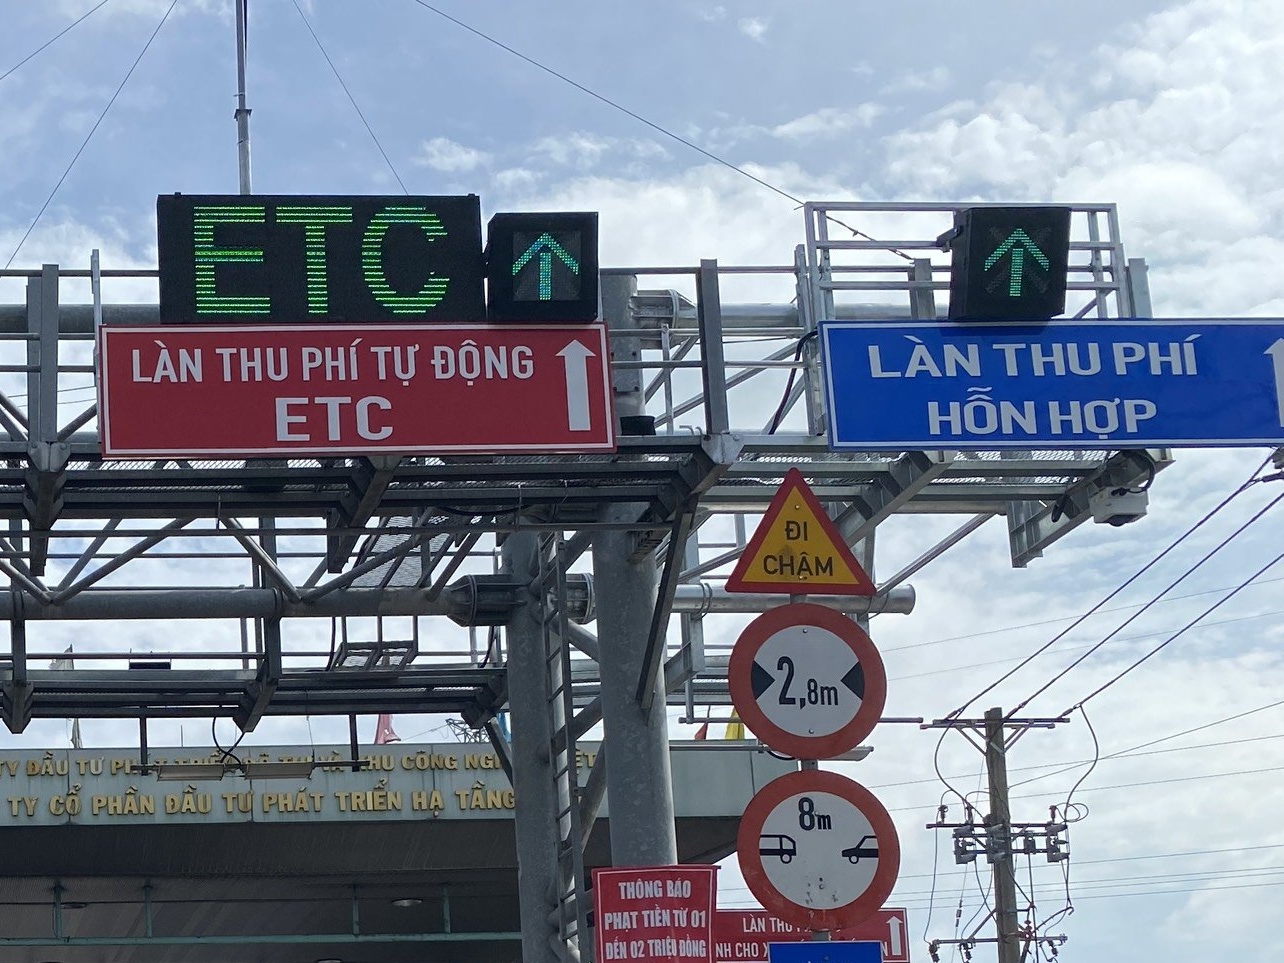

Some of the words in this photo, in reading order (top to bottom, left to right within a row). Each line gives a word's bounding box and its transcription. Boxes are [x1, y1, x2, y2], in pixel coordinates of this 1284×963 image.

[193, 205, 451, 315] ETC
[132, 340, 203, 383] LÀN
[216, 346, 289, 383] THU
[302, 338, 362, 382] PHÍ
[370, 344, 421, 387] TỰ
[430, 339, 534, 387] ĐỘNG
[867, 335, 981, 379] LÀN
[993, 342, 1101, 377] THU
[1113, 333, 1202, 377] PHÍ
[275, 395, 394, 443] ETC
[928, 386, 1037, 436] HỖN
[1049, 396, 1157, 441] HỢP
[784, 520, 808, 542] ĐI
[776, 656, 839, 710] 2,8m
[27, 751, 69, 777] ĐẦU
[77, 756, 104, 775] TƯ
[402, 750, 458, 771] CÔNG
[8, 796, 38, 817] TY
[49, 783, 83, 817] CỔ
[92, 785, 156, 816] PHẦN
[165, 785, 212, 815] ĐẦU
[222, 789, 253, 814] TƯ
[262, 786, 324, 814] PHÁT
[335, 777, 404, 812] TRIỂN
[455, 780, 515, 811] TẦNG
[798, 797, 832, 831] 8m
[618, 879, 663, 899] THÔNG
[666, 878, 691, 898] BÁO
[604, 911, 638, 932] PHẠT
[642, 904, 670, 928] TIỀN
[673, 907, 689, 927] TỪ
[691, 910, 706, 928] 01
[743, 914, 766, 933] LÀN
[606, 936, 627, 960] ĐẾN
[630, 940, 645, 958] 02
[647, 936, 677, 959] TRIỆU
[679, 934, 706, 958] ĐỒNG
[735, 942, 759, 958] CHO
